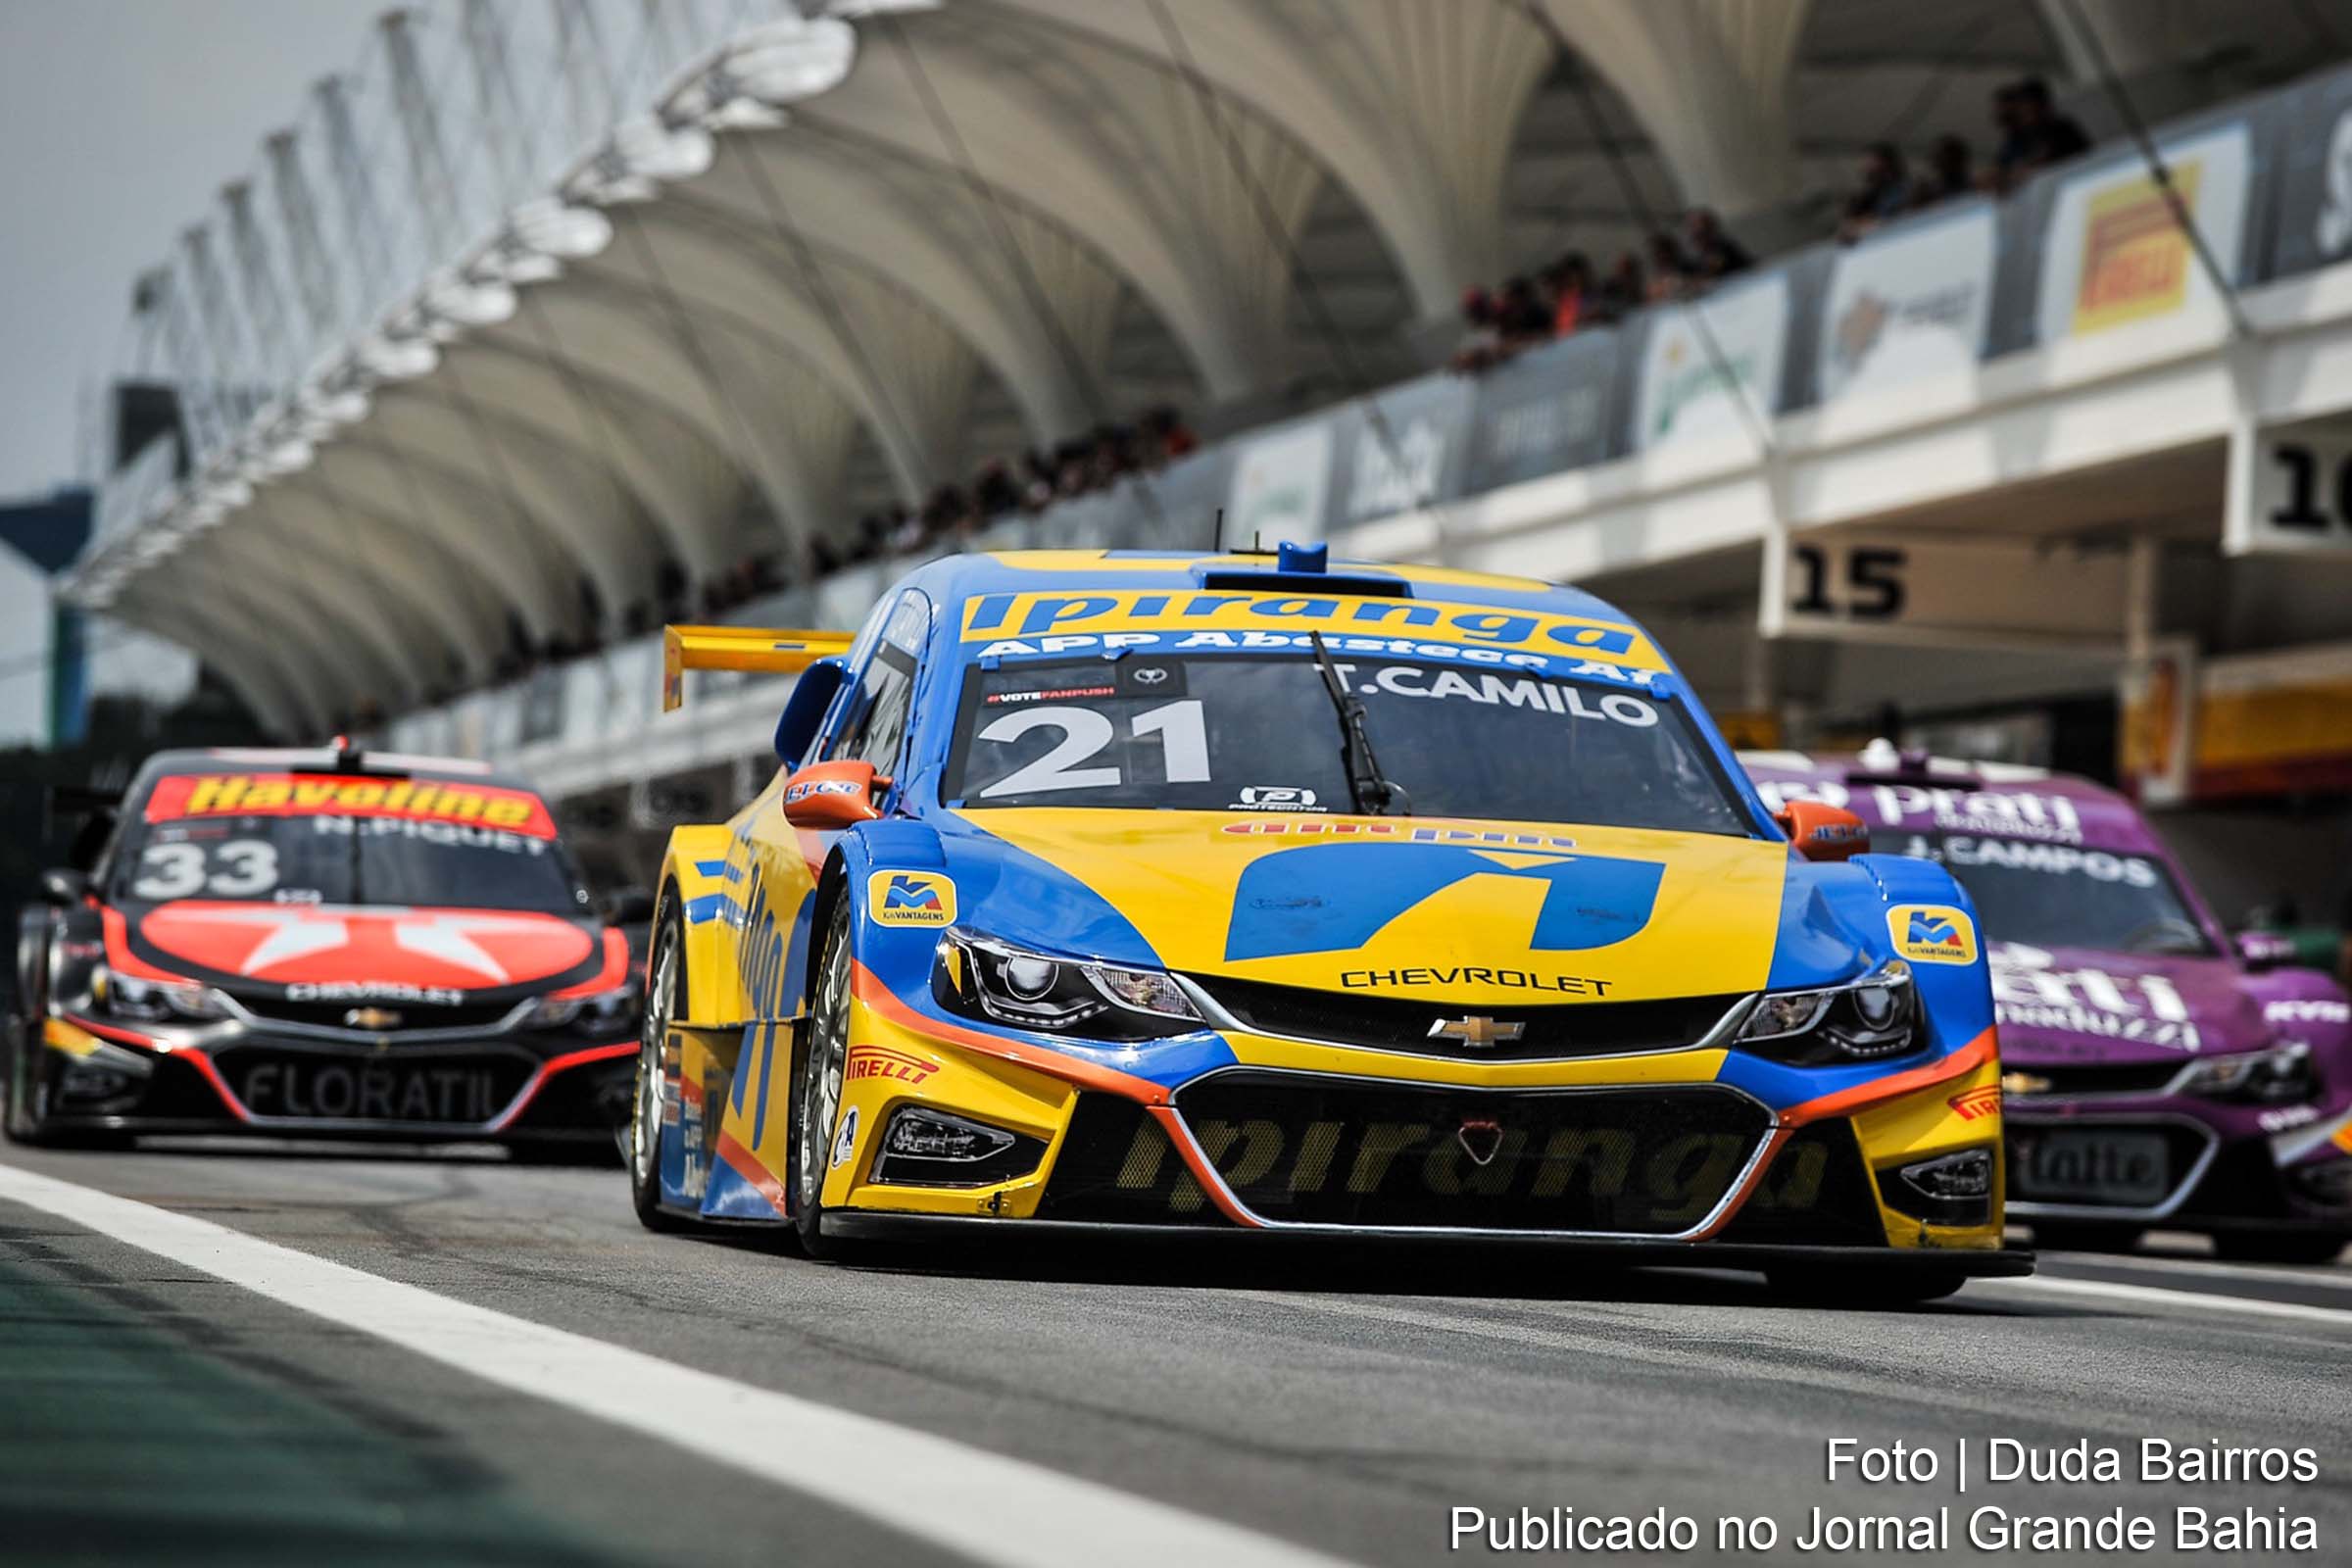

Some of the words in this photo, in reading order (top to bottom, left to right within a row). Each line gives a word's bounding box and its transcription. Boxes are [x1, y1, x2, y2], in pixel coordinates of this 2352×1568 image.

[1792, 545, 1907, 620] 15
[968, 595, 1635, 654] Ipiranga
[977, 632, 1160, 658] APP
[1175, 632, 1548, 669] Abastece
[1314, 662, 1659, 727] T.CAMILO
[978, 699, 1211, 799] 21
[186, 775, 536, 828] Havoline
[314, 814, 546, 856] N.PIQUET
[1905, 835, 2157, 887] J.CAMPOS
[133, 838, 279, 900] 33
[1341, 967, 1613, 997] CHEVROLET
[846, 1045, 940, 1085] PIRELLI
[1945, 1083, 2000, 1121] PIR
